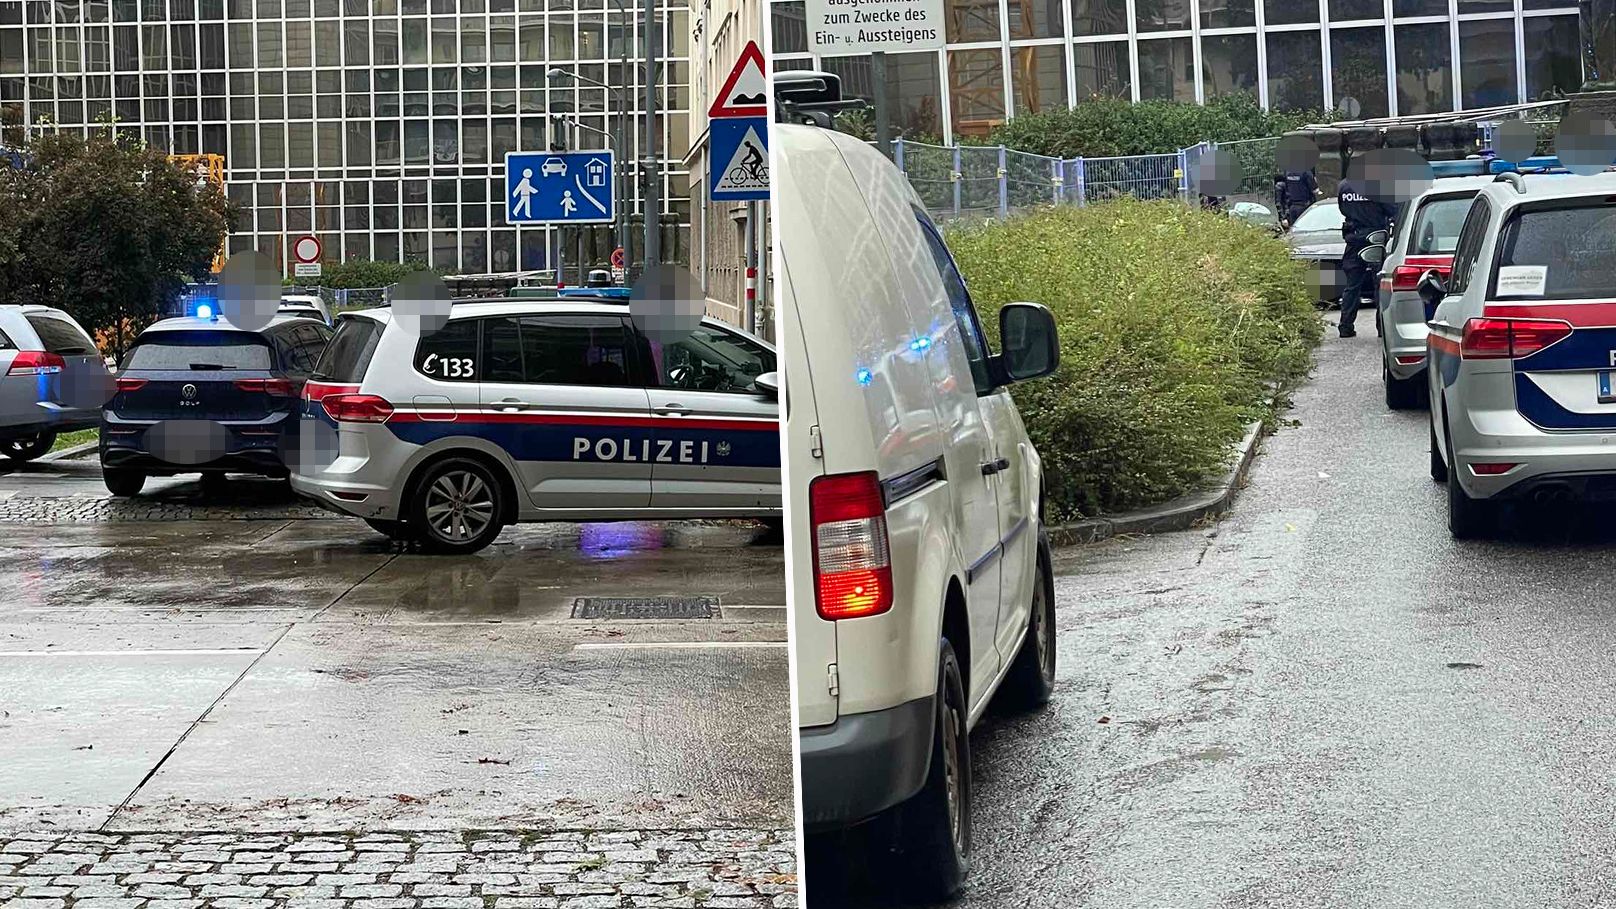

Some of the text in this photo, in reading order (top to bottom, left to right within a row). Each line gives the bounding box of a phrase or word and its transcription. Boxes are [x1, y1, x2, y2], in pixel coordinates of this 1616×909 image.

[824, 8, 926, 25] zum Zwecke des
[815, 31, 840, 45] Ein-
[858, 27, 937, 44] Aussteigens
[440, 358, 475, 377] 133
[573, 437, 708, 464] POLIZEI
